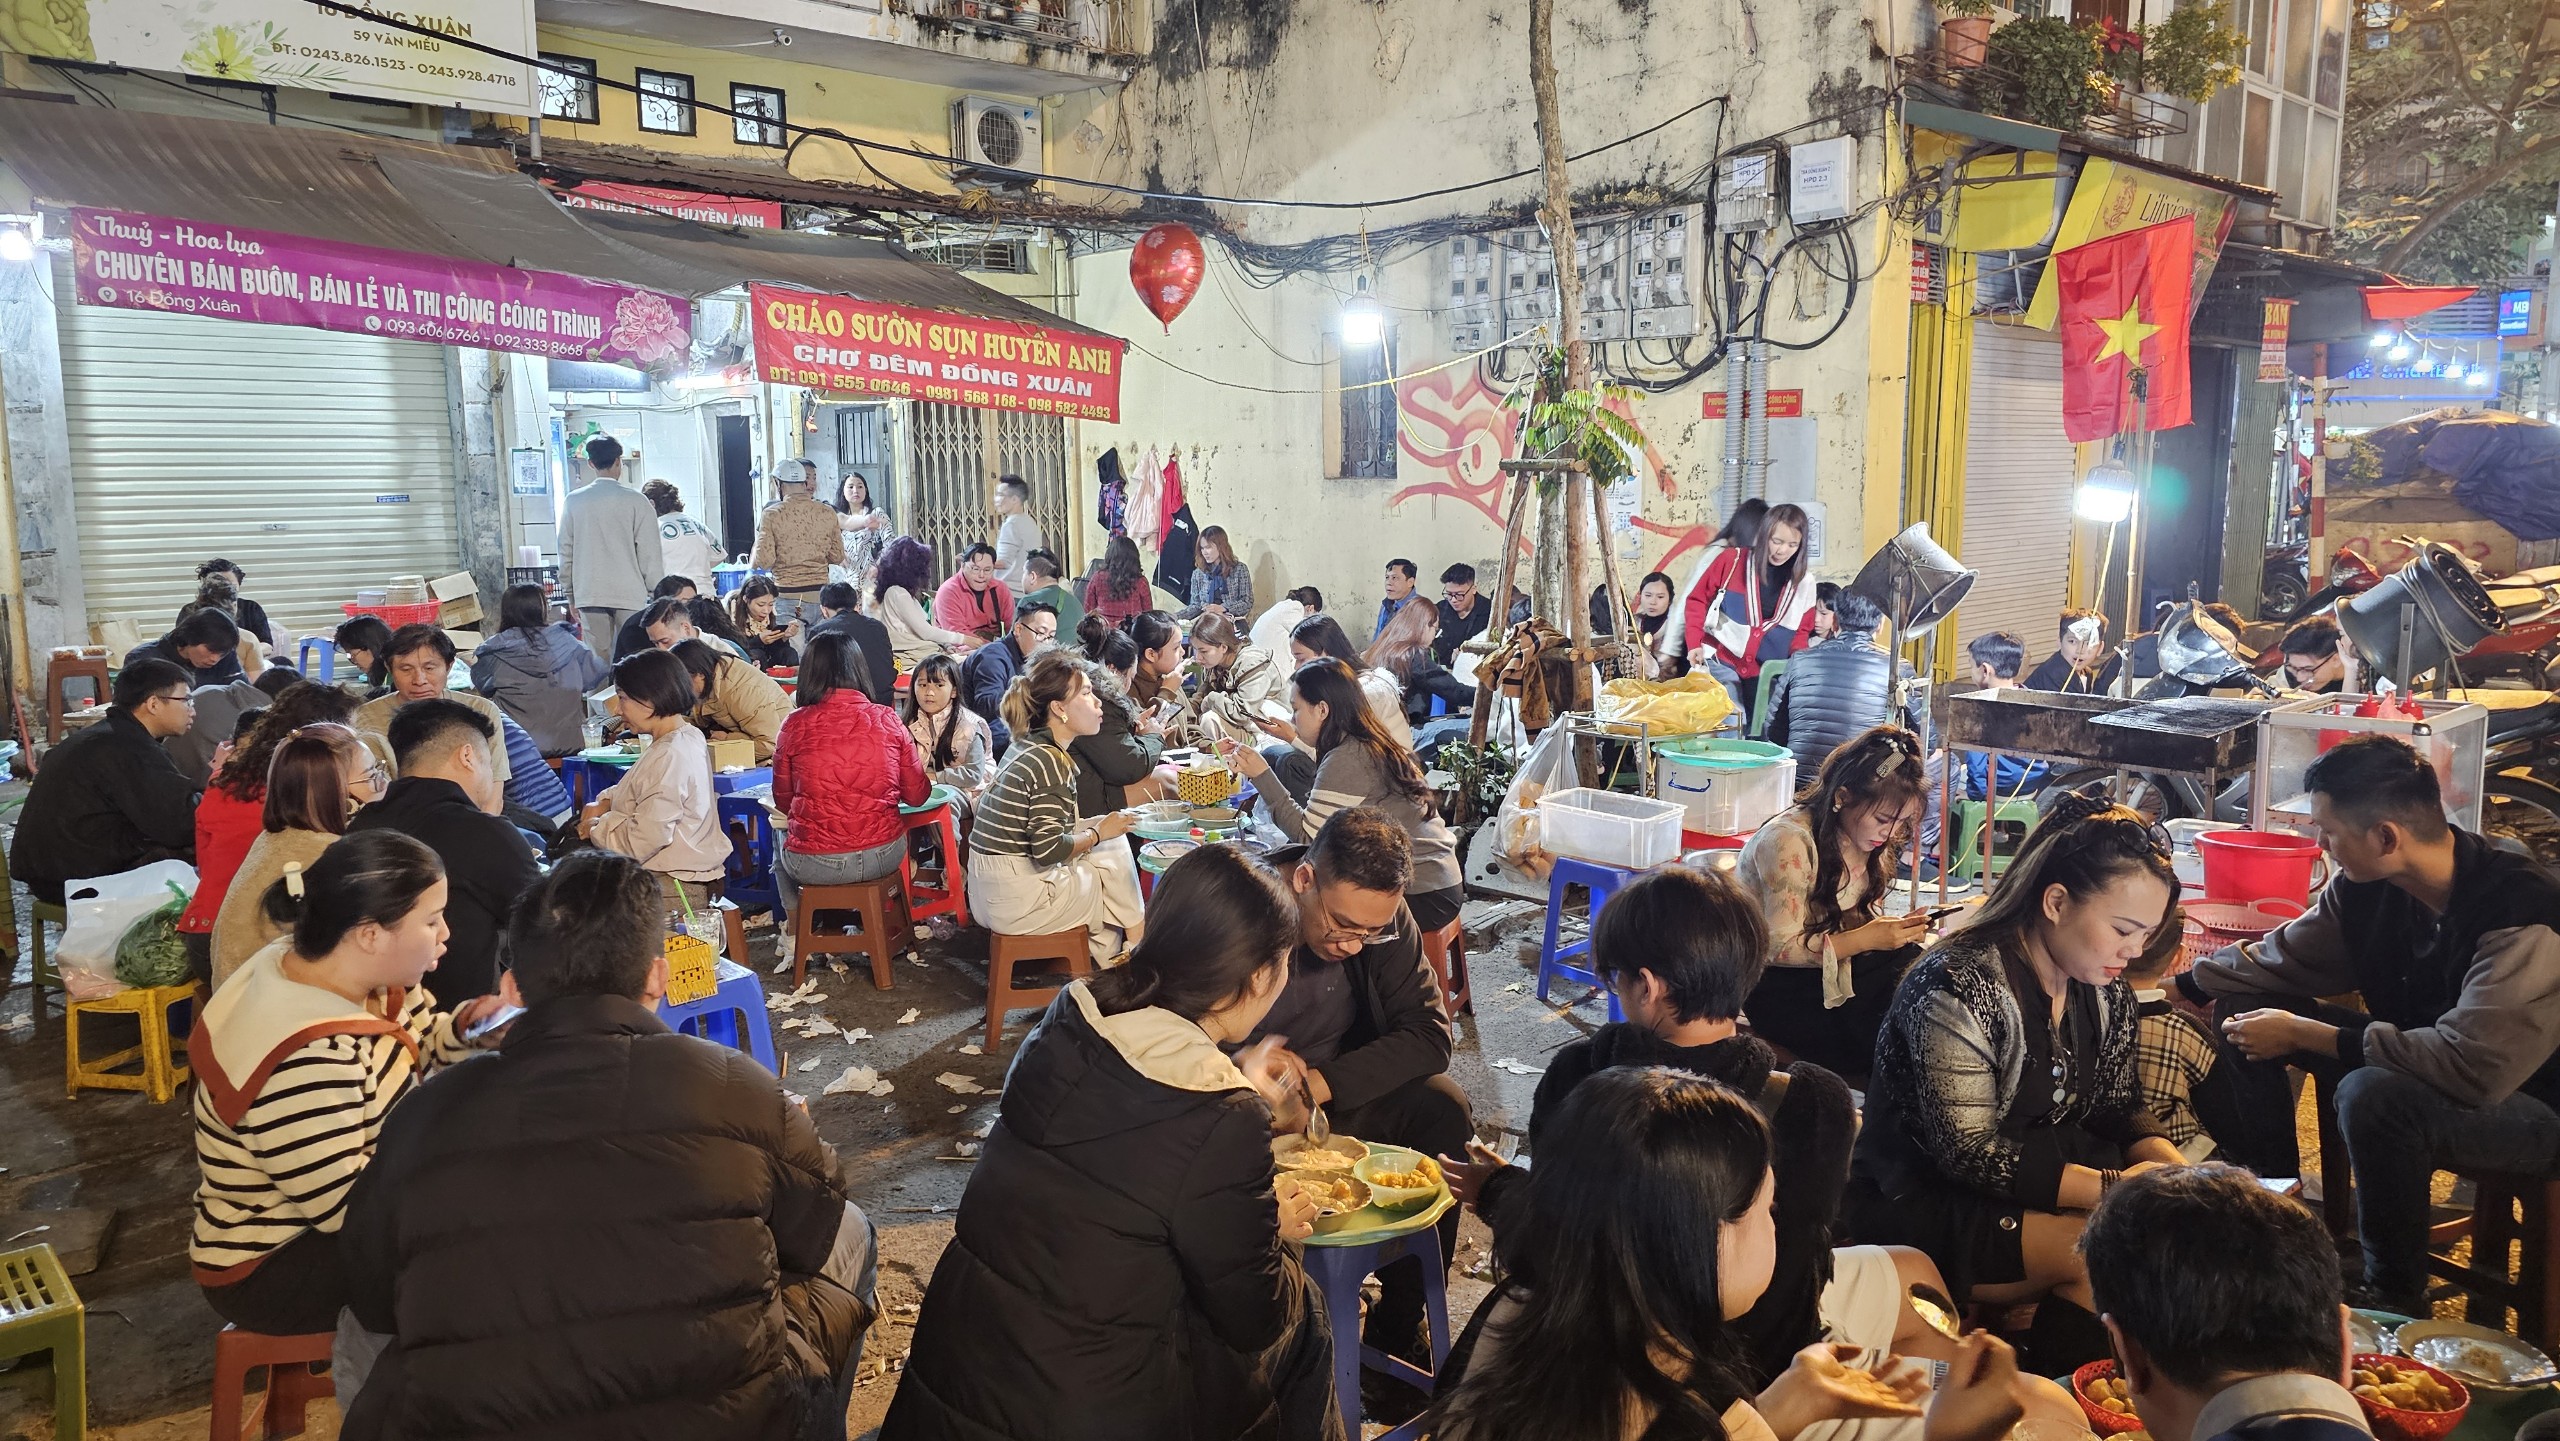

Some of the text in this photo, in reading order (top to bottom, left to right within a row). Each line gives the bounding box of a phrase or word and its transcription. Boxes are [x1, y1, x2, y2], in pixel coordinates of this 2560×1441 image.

[353, 30, 440, 53] 59 VĂN MIẾU
[414, 13, 472, 38] XUÂN
[272, 42, 297, 57] ĐT:
[300, 46, 406, 71] 0243.826.1523
[417, 63, 516, 87] 0243.928.4718
[732, 213, 765, 228] ANH
[1929, 212, 1940, 230] 12
[176, 225, 223, 251] Hoa
[226, 231, 265, 258] lụa
[95, 250, 601, 340] CHUYÊN BÁN BUÔN, BÁN LẺ VÀ THI CÔNG CÔNG TRÌNH
[126, 290, 241, 315] 16 Đồng Xuân
[2512, 301, 2530, 314] MB
[387, 319, 415, 335] 093
[446, 327, 480, 344] 6766
[551, 341, 583, 357] 8668
[767, 299, 1112, 376] CHÁO SƯỜN SỤN HUYỀN ANH
[793, 345, 1093, 398] CHỢ ĐÊM ĐỒNG XUÂN
[769, 366, 796, 382] ĐT:
[799, 369, 827, 386] 091
[833, 374, 866, 391] 555
[870, 378, 911, 396] 0646
[926, 385, 958, 401] 0981
[964, 389, 988, 405] 568
[1028, 397, 1051, 412] 098
[1055, 401, 1078, 415] 582
[1081, 403, 1111, 419] 4493
